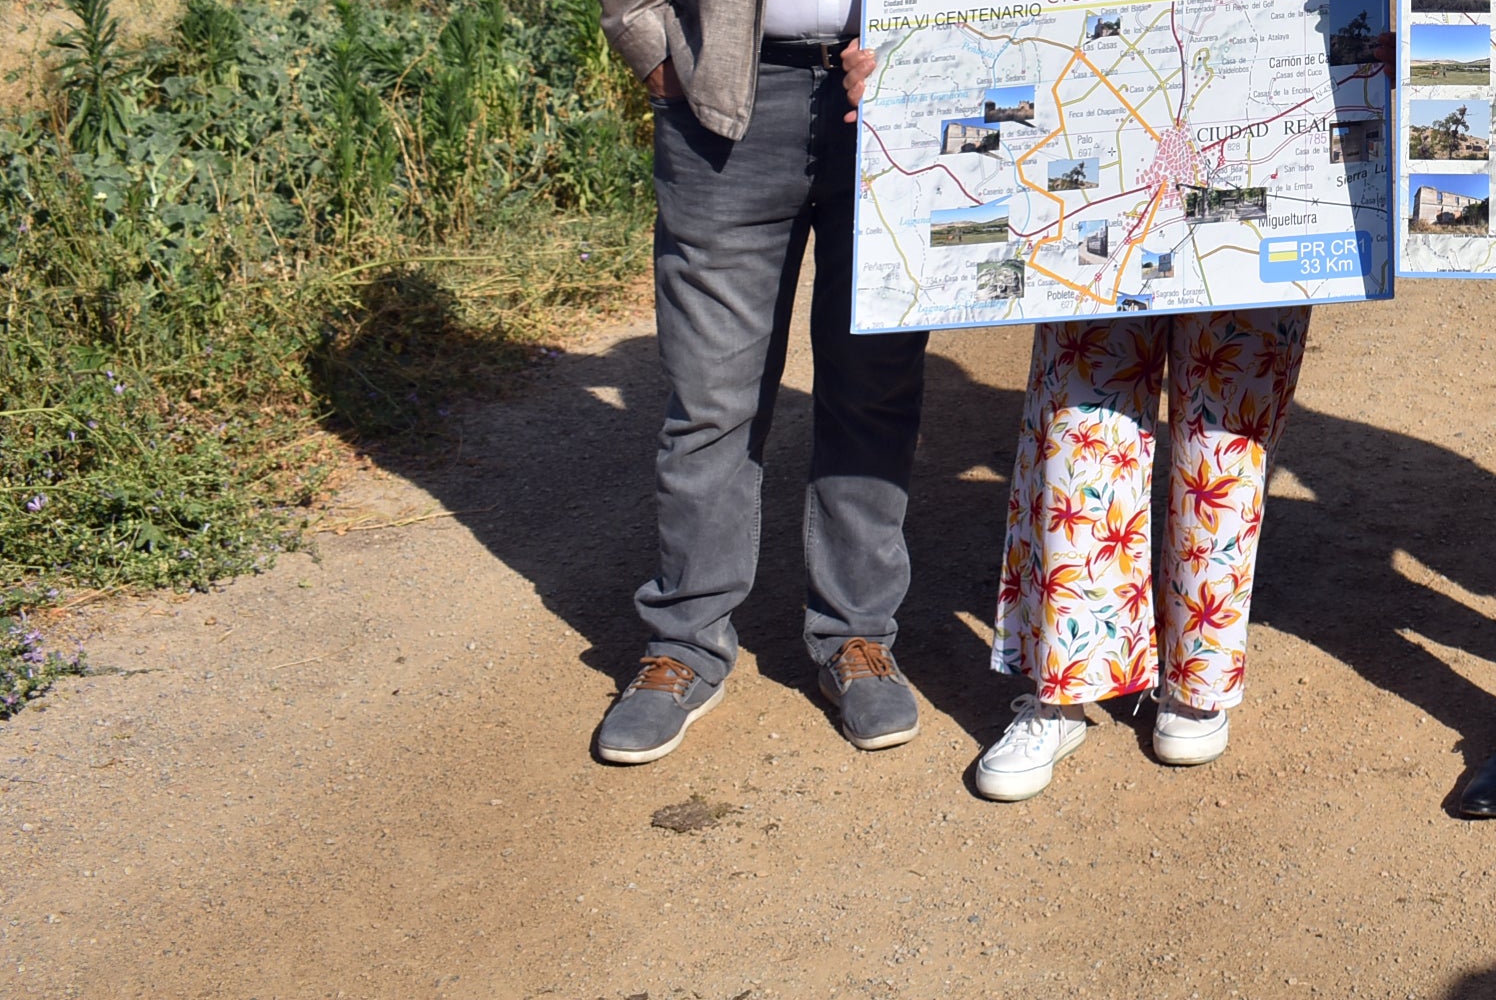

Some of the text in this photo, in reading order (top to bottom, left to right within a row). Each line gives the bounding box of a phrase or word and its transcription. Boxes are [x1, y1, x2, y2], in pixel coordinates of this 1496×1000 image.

[1263, 0, 1275, 9] Golf
[869, 3, 1042, 33] RUTA VI CENTENARIO
[1270, 12, 1285, 20] Casa
[1083, 41, 1117, 52] Las Casas
[1269, 56, 1301, 69] Carrión
[1304, 55, 1317, 65] de
[1276, 72, 1294, 80] Casas
[1307, 69, 1322, 77] Cuco
[1129, 86, 1144, 94] Casa
[1197, 117, 1330, 143] CIUDAD REAL
[1077, 135, 1093, 145] Palo
[1307, 132, 1327, 145] 785
[1077, 148, 1092, 157] 697
[1227, 143, 1241, 151] 828
[1295, 148, 1310, 156] Casa
[1298, 164, 1314, 172] Isidro
[1336, 170, 1368, 188] Sierra
[1276, 184, 1283, 192] de
[1285, 183, 1292, 191] la
[1258, 212, 1318, 230] Miguelturra
[1301, 241, 1325, 258] PR
[1300, 256, 1353, 275] 33 Km
[1047, 290, 1075, 301] Poblete
[1155, 289, 1180, 300] Sagrado
[1061, 300, 1074, 309] 627
[1167, 298, 1175, 306] de
